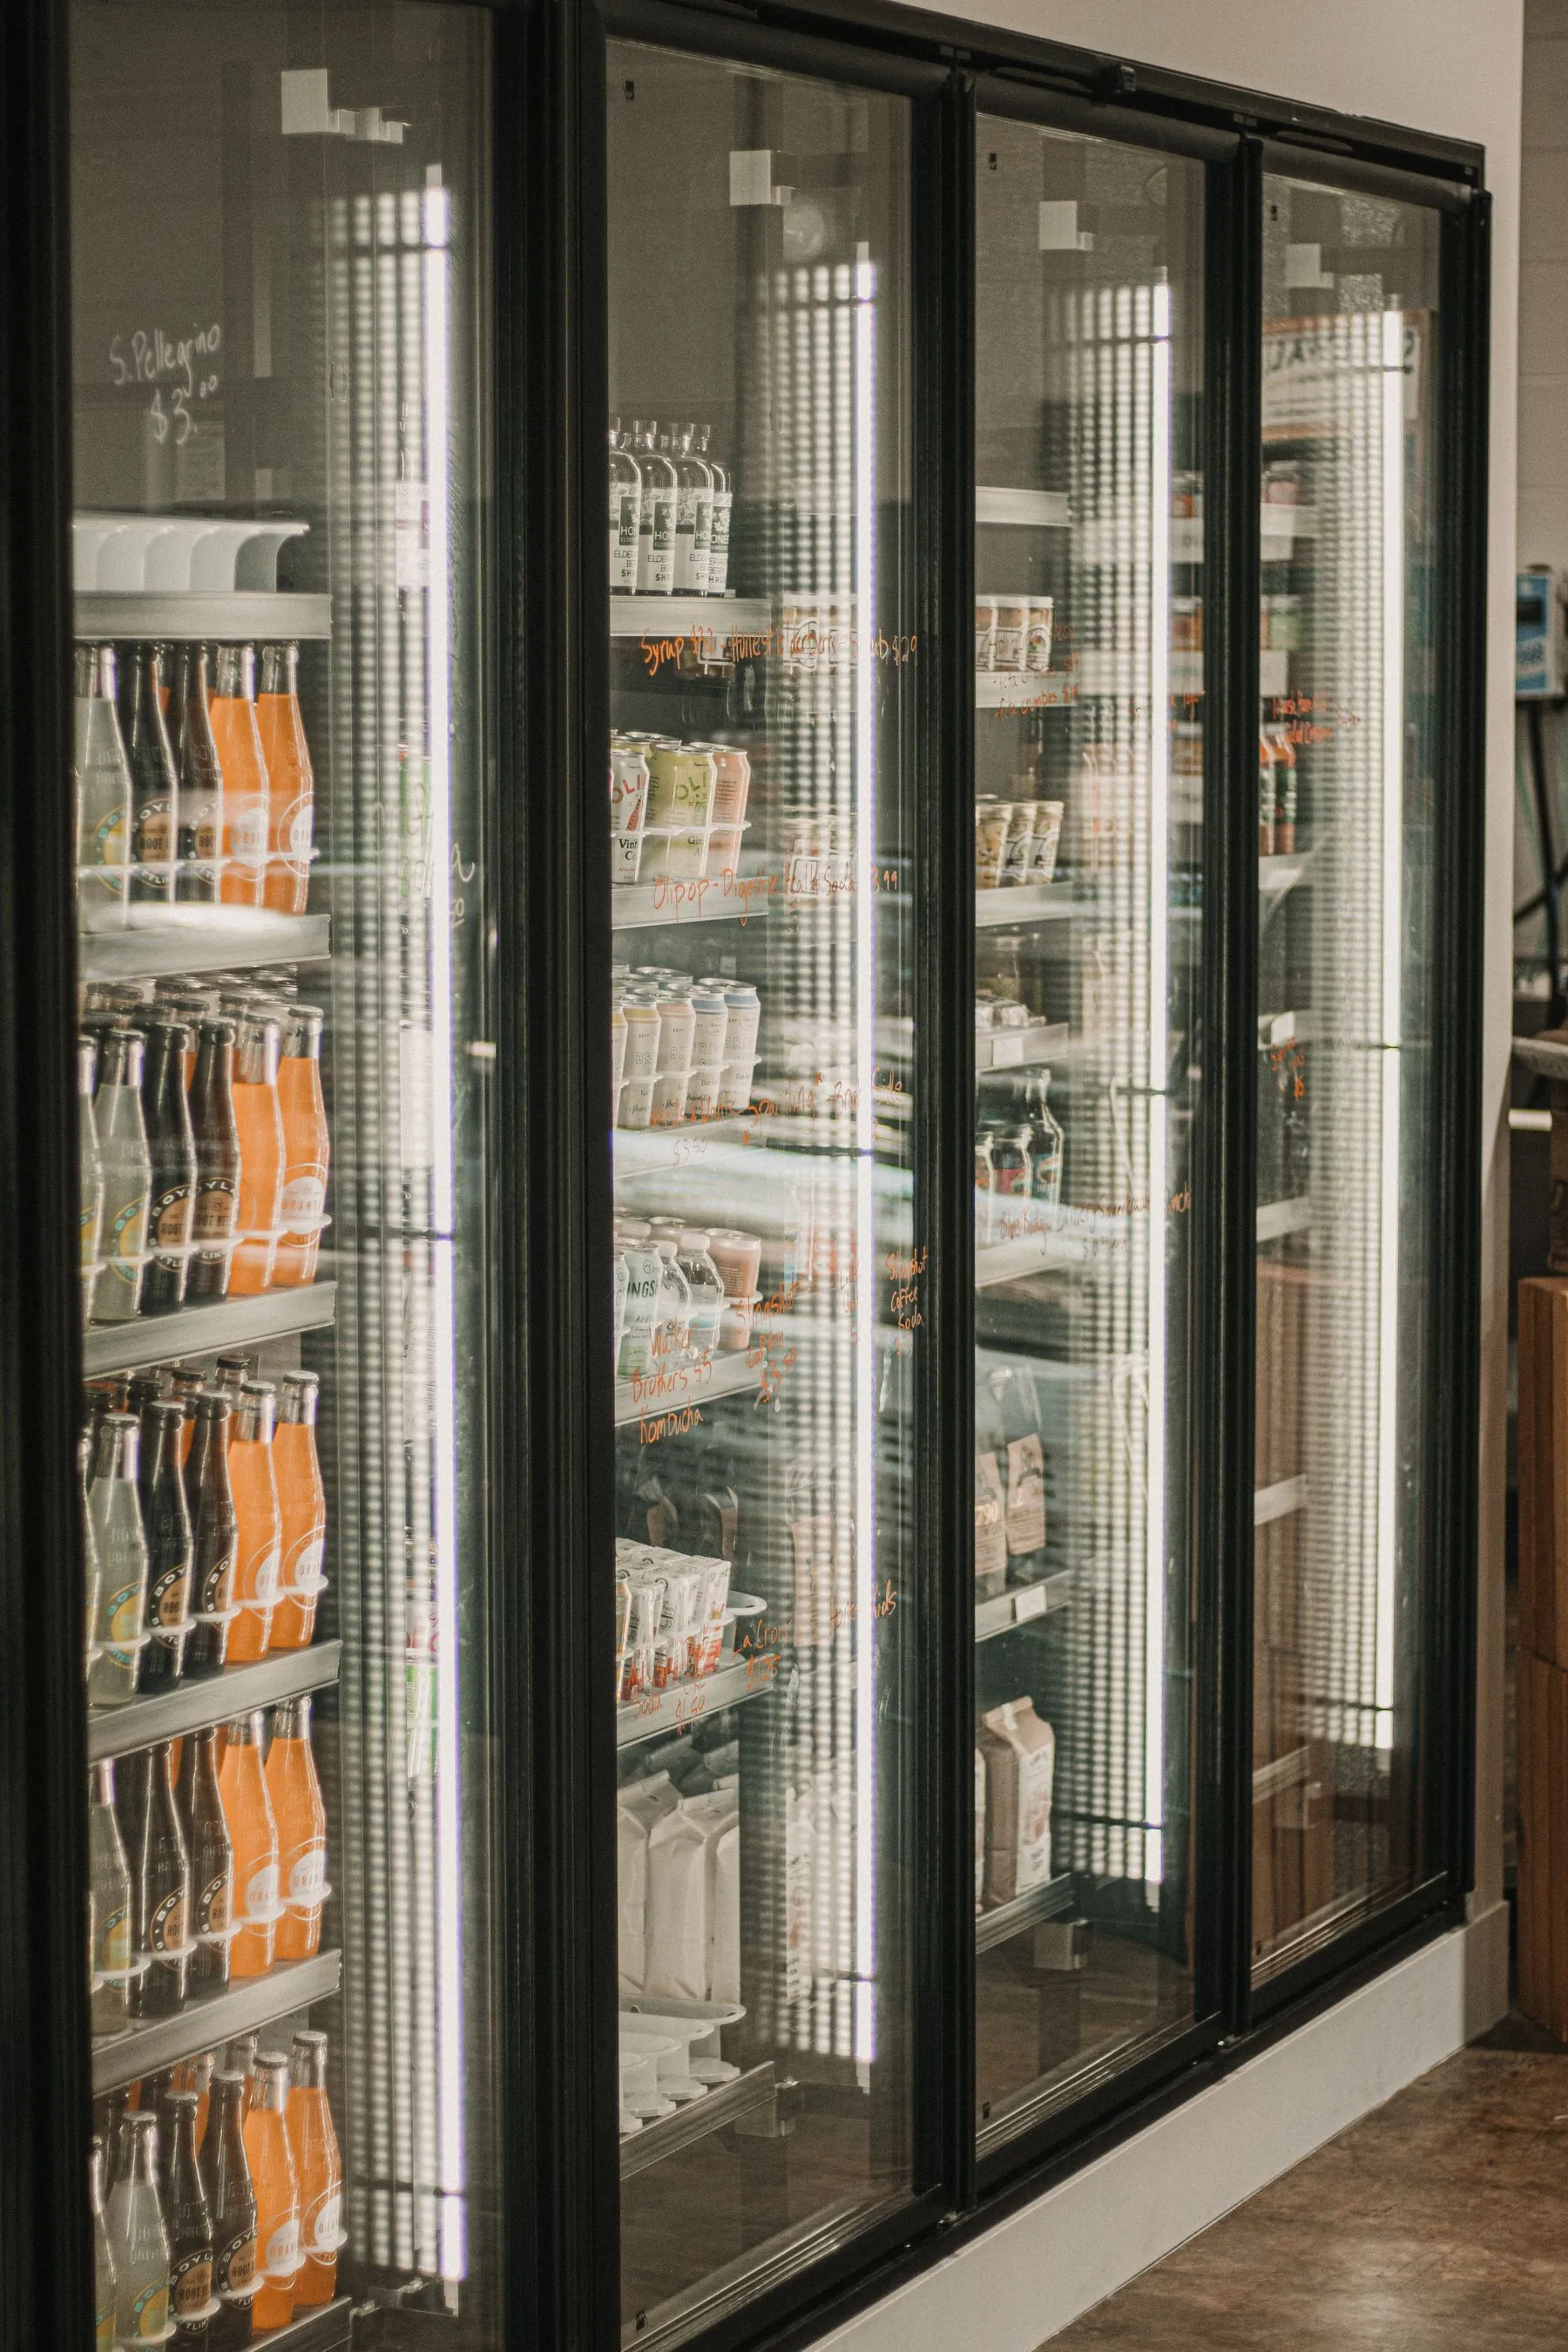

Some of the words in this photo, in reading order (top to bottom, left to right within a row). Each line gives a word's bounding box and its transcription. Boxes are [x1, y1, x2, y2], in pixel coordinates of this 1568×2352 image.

[640, 618, 685, 677] Syrup
[653, 873, 709, 924] Olipop
[889, 1285, 919, 1313] Coffee
[898, 1305, 924, 1331] Soda
[632, 1361, 689, 1404] Brothers
[638, 1396, 705, 1445] Kombucha
